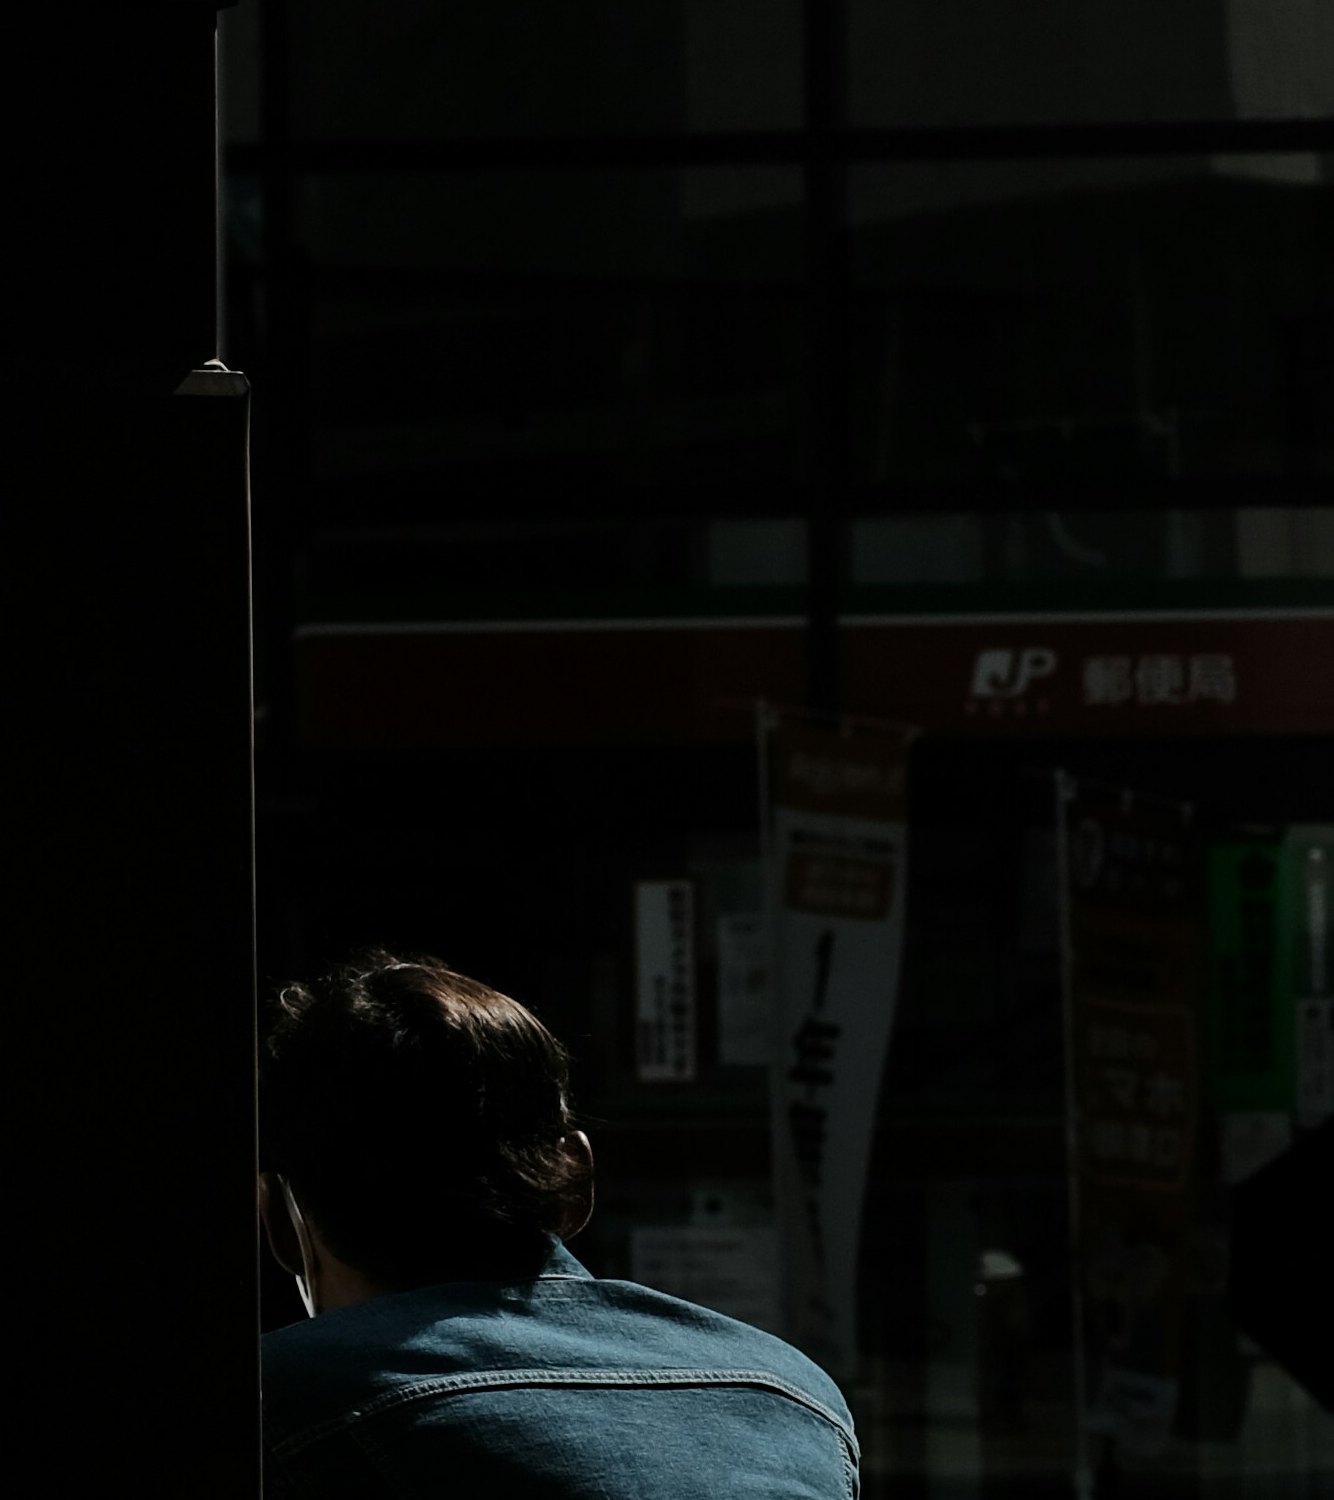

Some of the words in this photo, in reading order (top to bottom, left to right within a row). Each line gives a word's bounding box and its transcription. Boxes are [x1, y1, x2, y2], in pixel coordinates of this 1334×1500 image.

[969, 646, 1059, 698] JP
[1082, 652, 1238, 707] 郵便局
